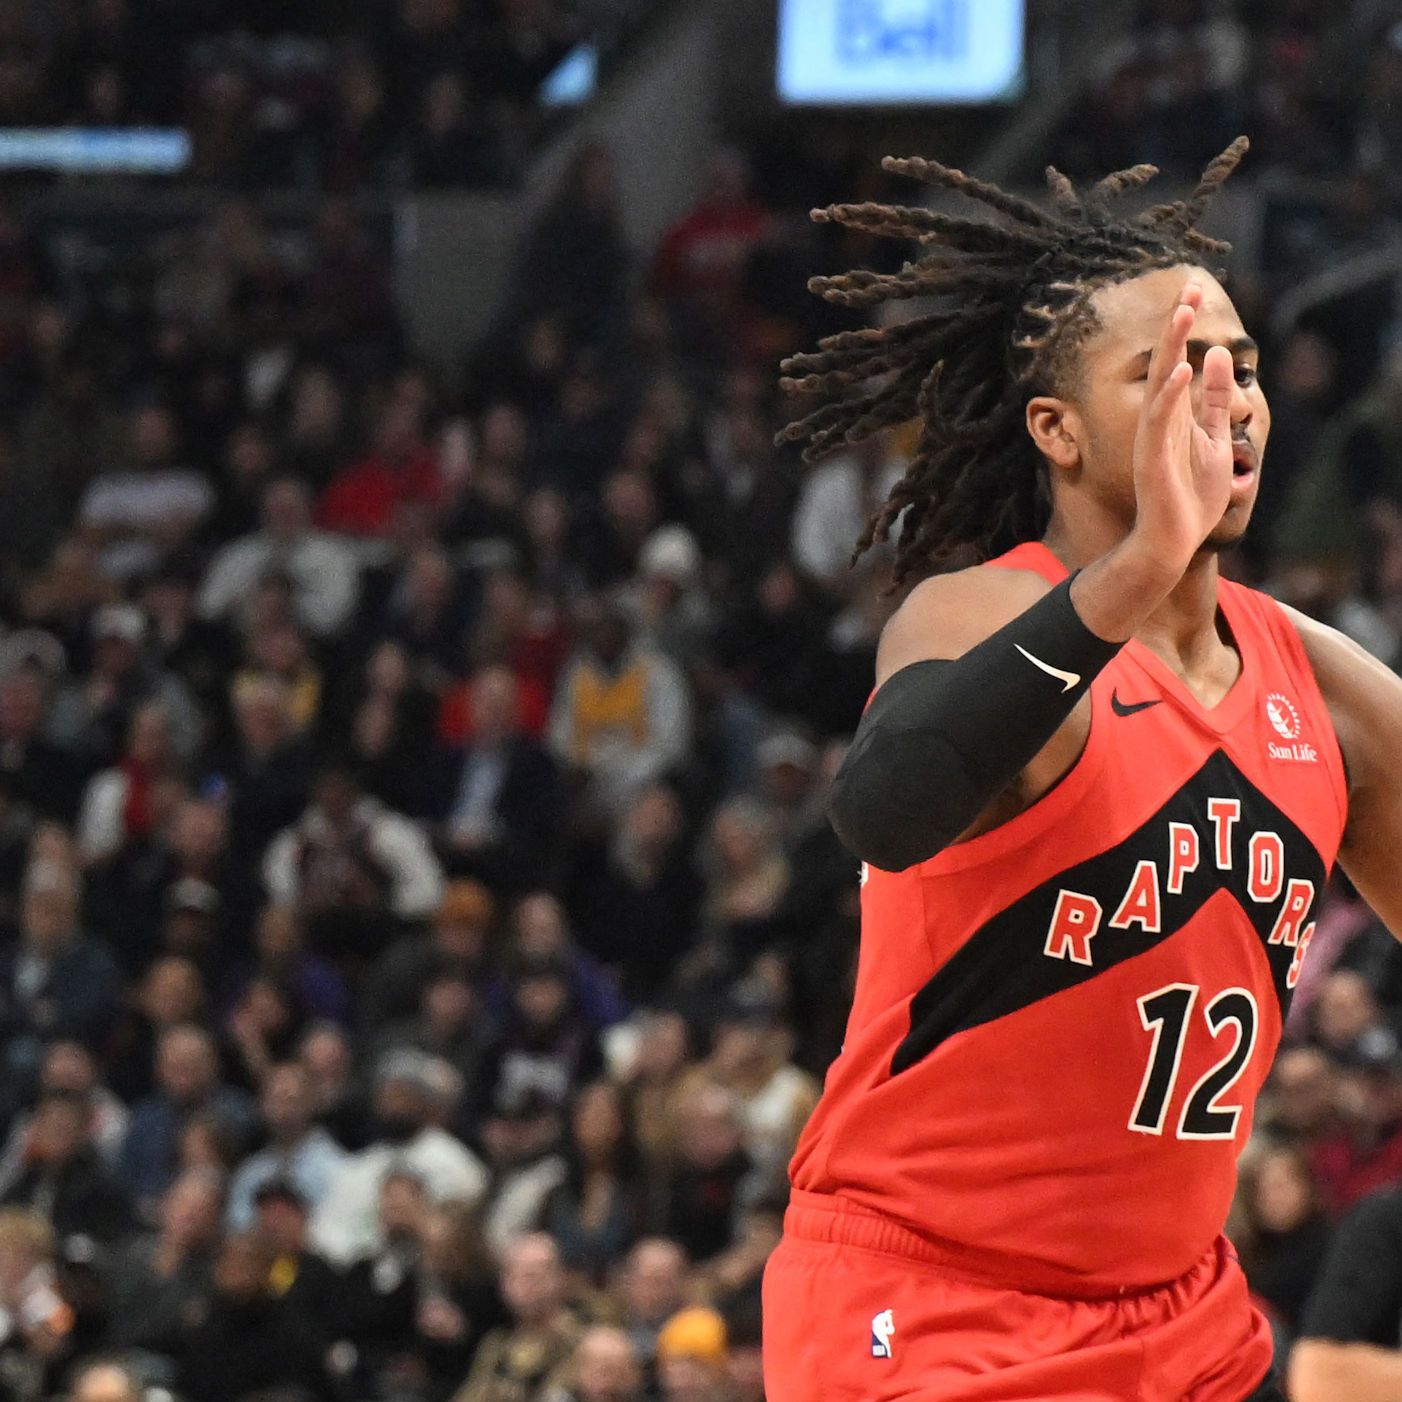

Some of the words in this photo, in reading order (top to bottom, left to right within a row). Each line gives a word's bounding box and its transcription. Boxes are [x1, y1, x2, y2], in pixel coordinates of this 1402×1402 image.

[1267, 741, 1293, 760] Sun
[1291, 743, 1318, 763] Life
[1043, 796, 1316, 990] RAPTORS
[1127, 981, 1258, 1141] 12
